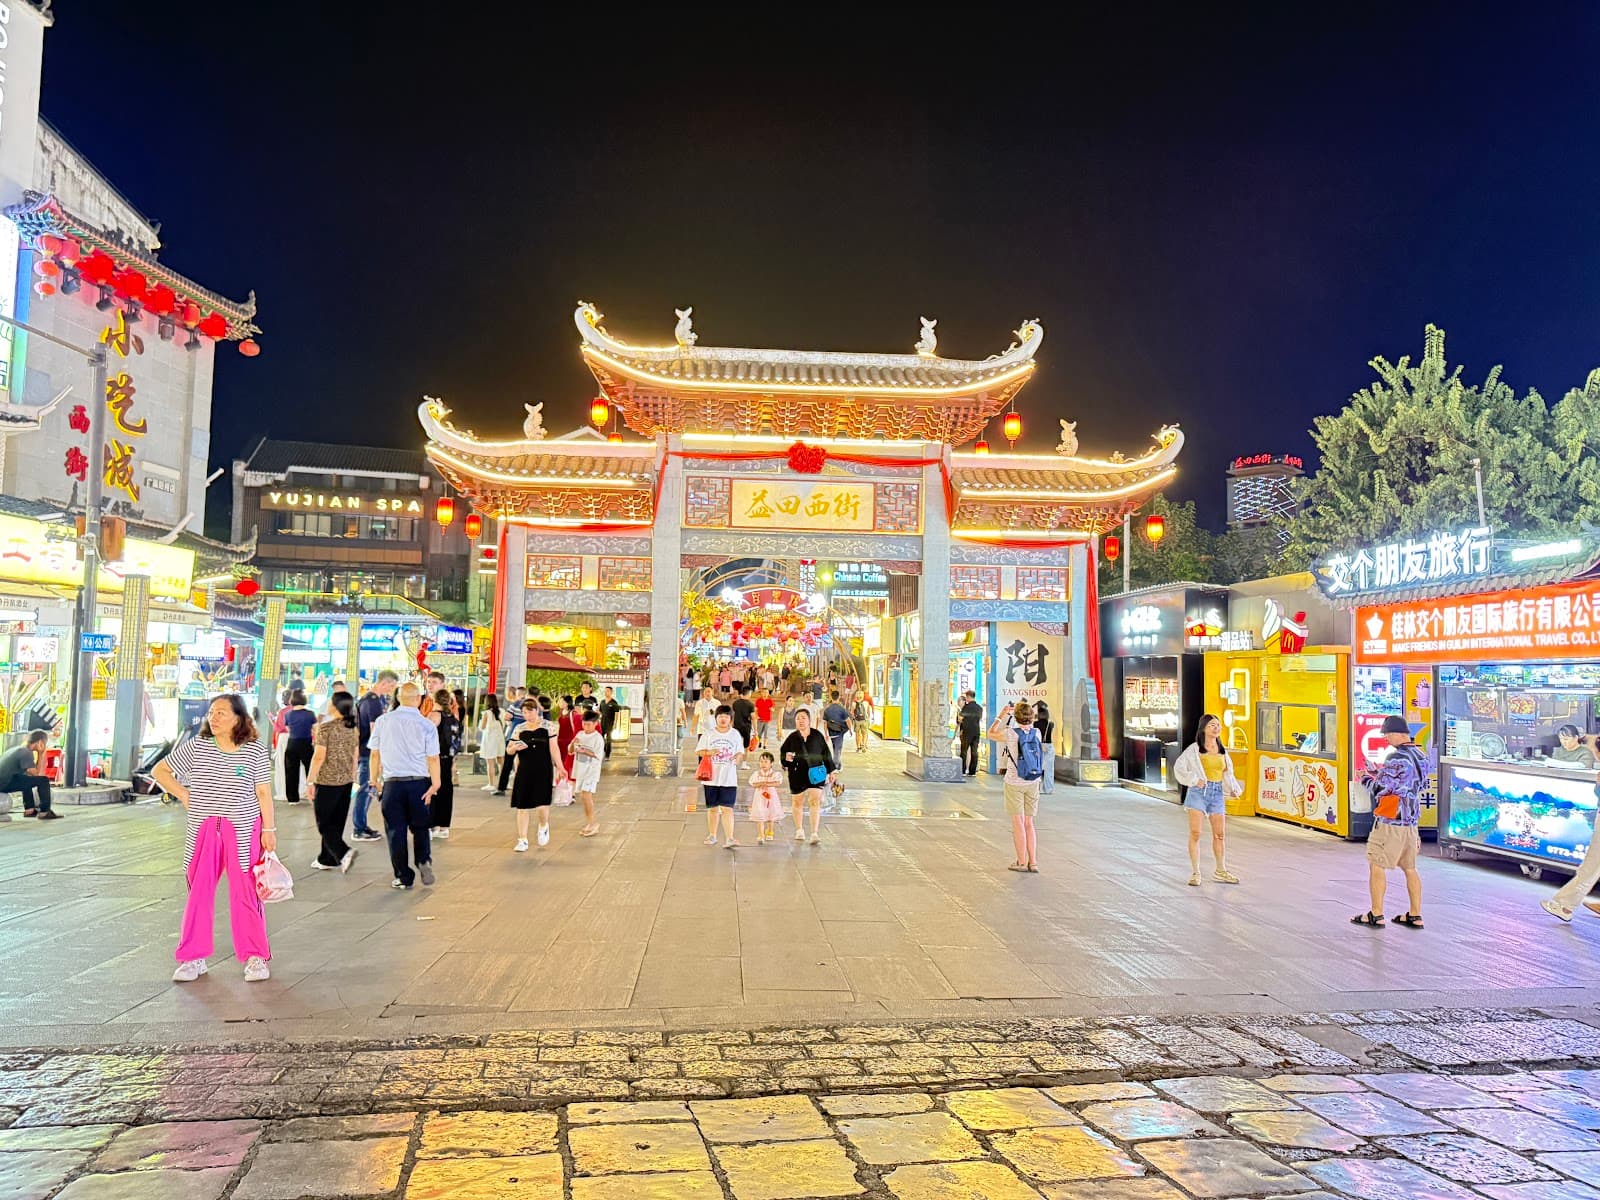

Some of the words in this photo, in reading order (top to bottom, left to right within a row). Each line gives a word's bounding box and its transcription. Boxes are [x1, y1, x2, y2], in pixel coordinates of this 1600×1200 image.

[64, 405, 91, 482] 西街
[269, 492, 360, 509] YUJIAN
[376, 498, 421, 512] SPA
[743, 489, 861, 521] 益田西街
[1327, 526, 1492, 592] 交个朋友旅行
[1470, 635, 1534, 648] INTERNATIONAL
[1534, 632, 1570, 646] TRAVEL
[1004, 639, 1049, 686] 阳
[1002, 688, 1047, 697] YANGSHUO
[1420, 793, 1436, 809] 半
